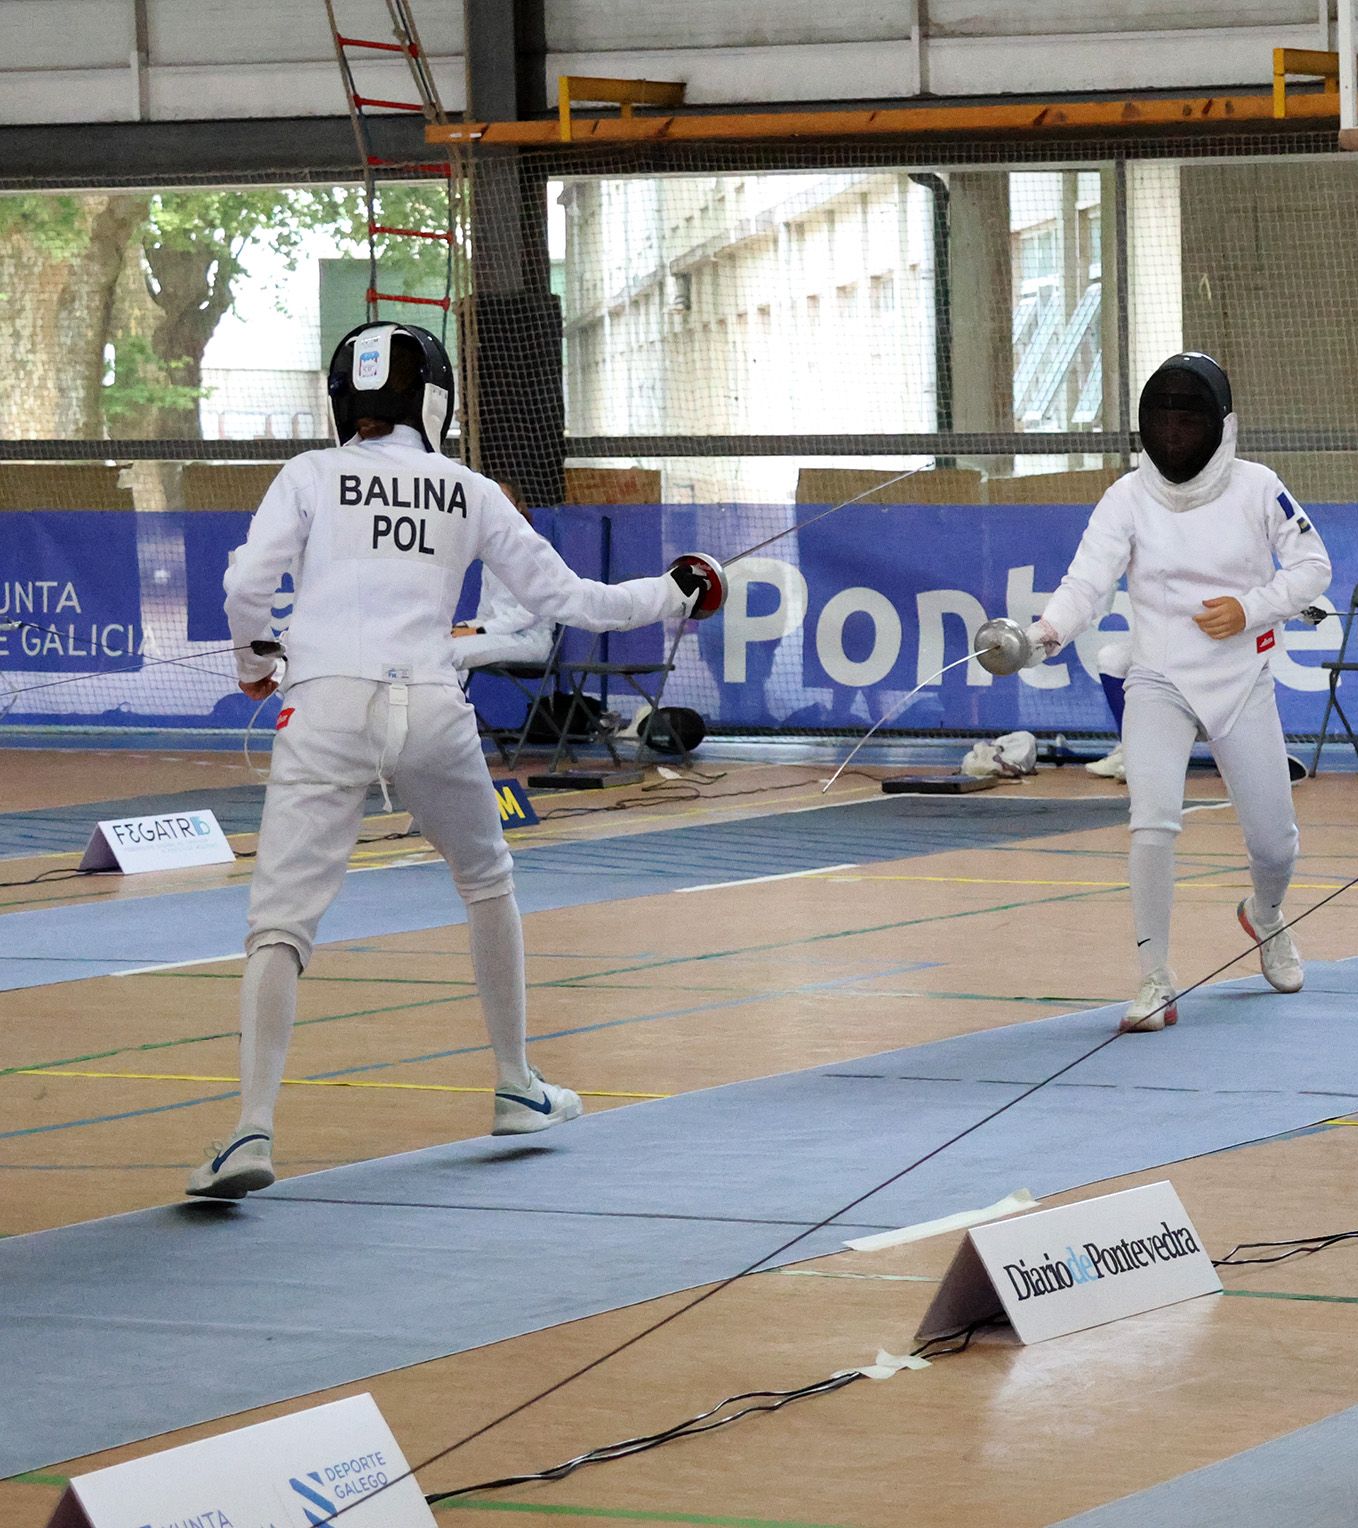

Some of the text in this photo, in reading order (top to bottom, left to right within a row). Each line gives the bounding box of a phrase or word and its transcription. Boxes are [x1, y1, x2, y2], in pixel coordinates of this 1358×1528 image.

[340, 474, 467, 519] BALINA
[372, 515, 435, 555] POL
[21, 624, 162, 657] GALICIA
[324, 1451, 387, 1483] DEPORTE
[334, 1471, 389, 1500] GALEGO
